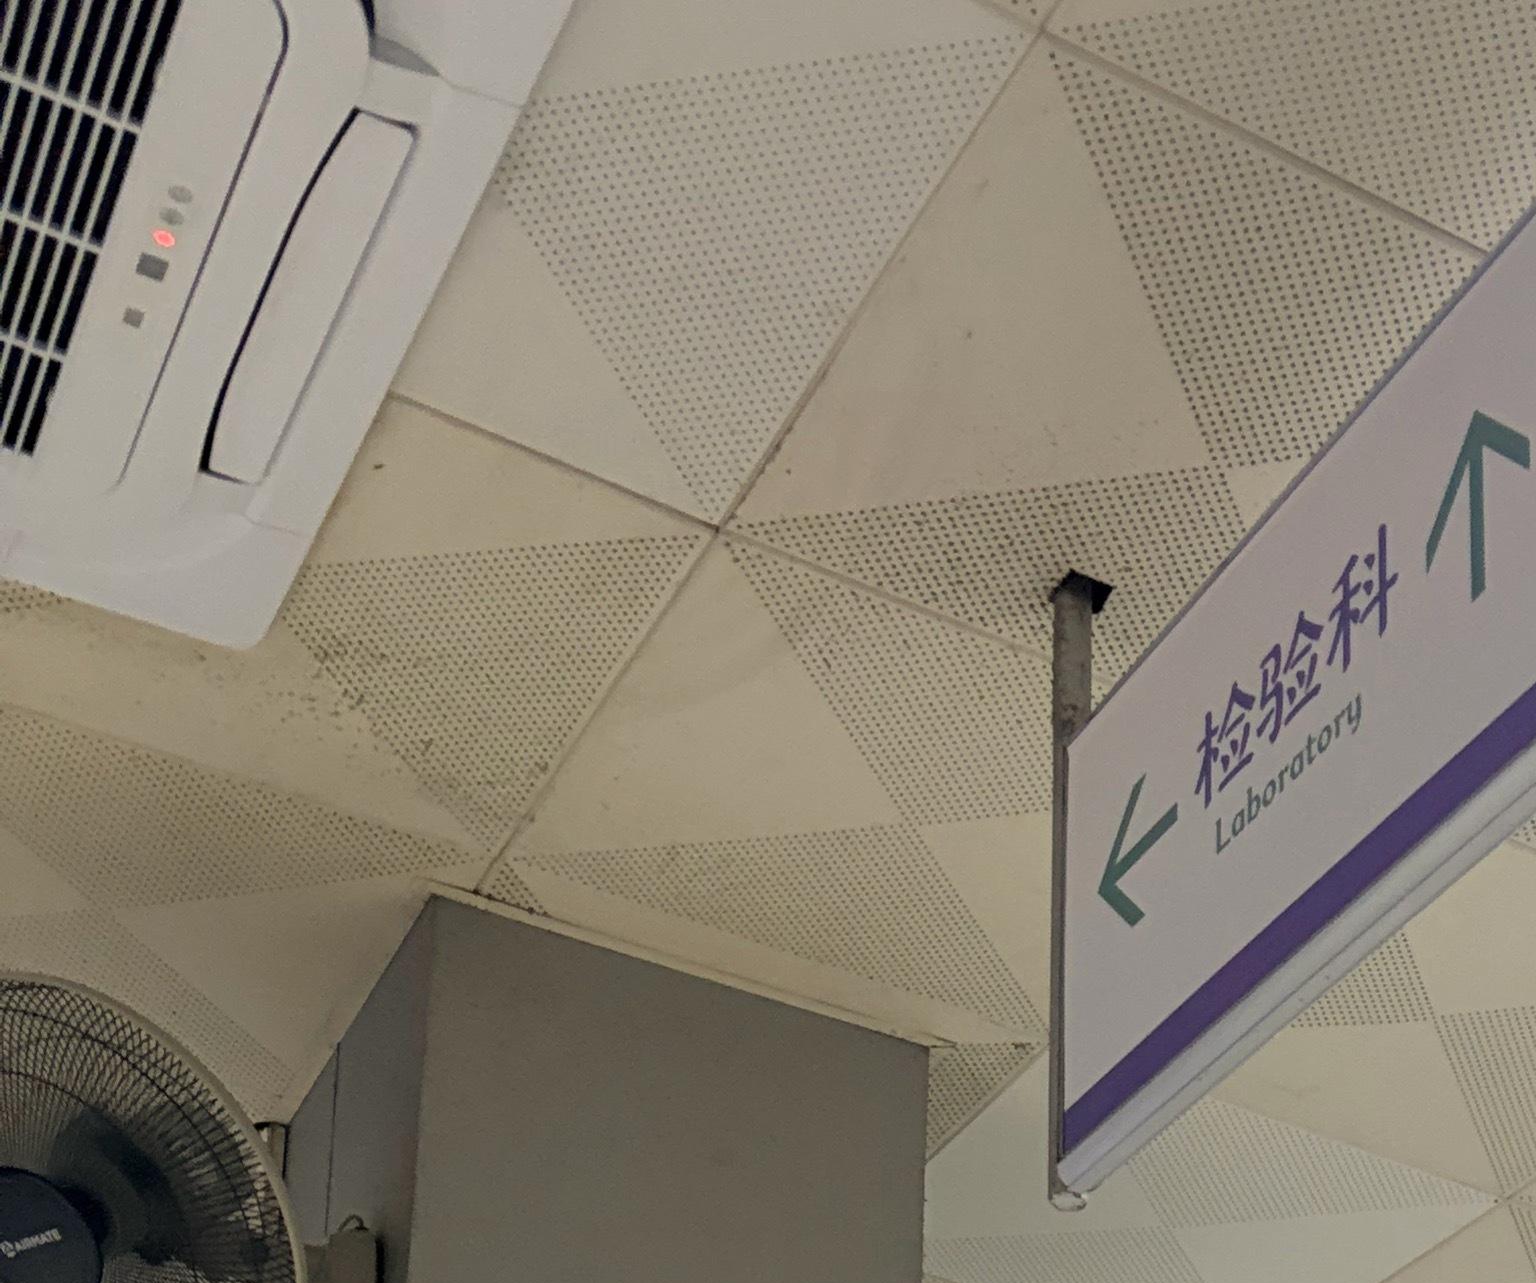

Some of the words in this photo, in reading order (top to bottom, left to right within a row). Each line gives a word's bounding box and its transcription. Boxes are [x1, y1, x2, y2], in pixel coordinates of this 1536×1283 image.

[1194, 523, 1399, 809] 检验科
[1215, 693, 1362, 854] Laboratory
